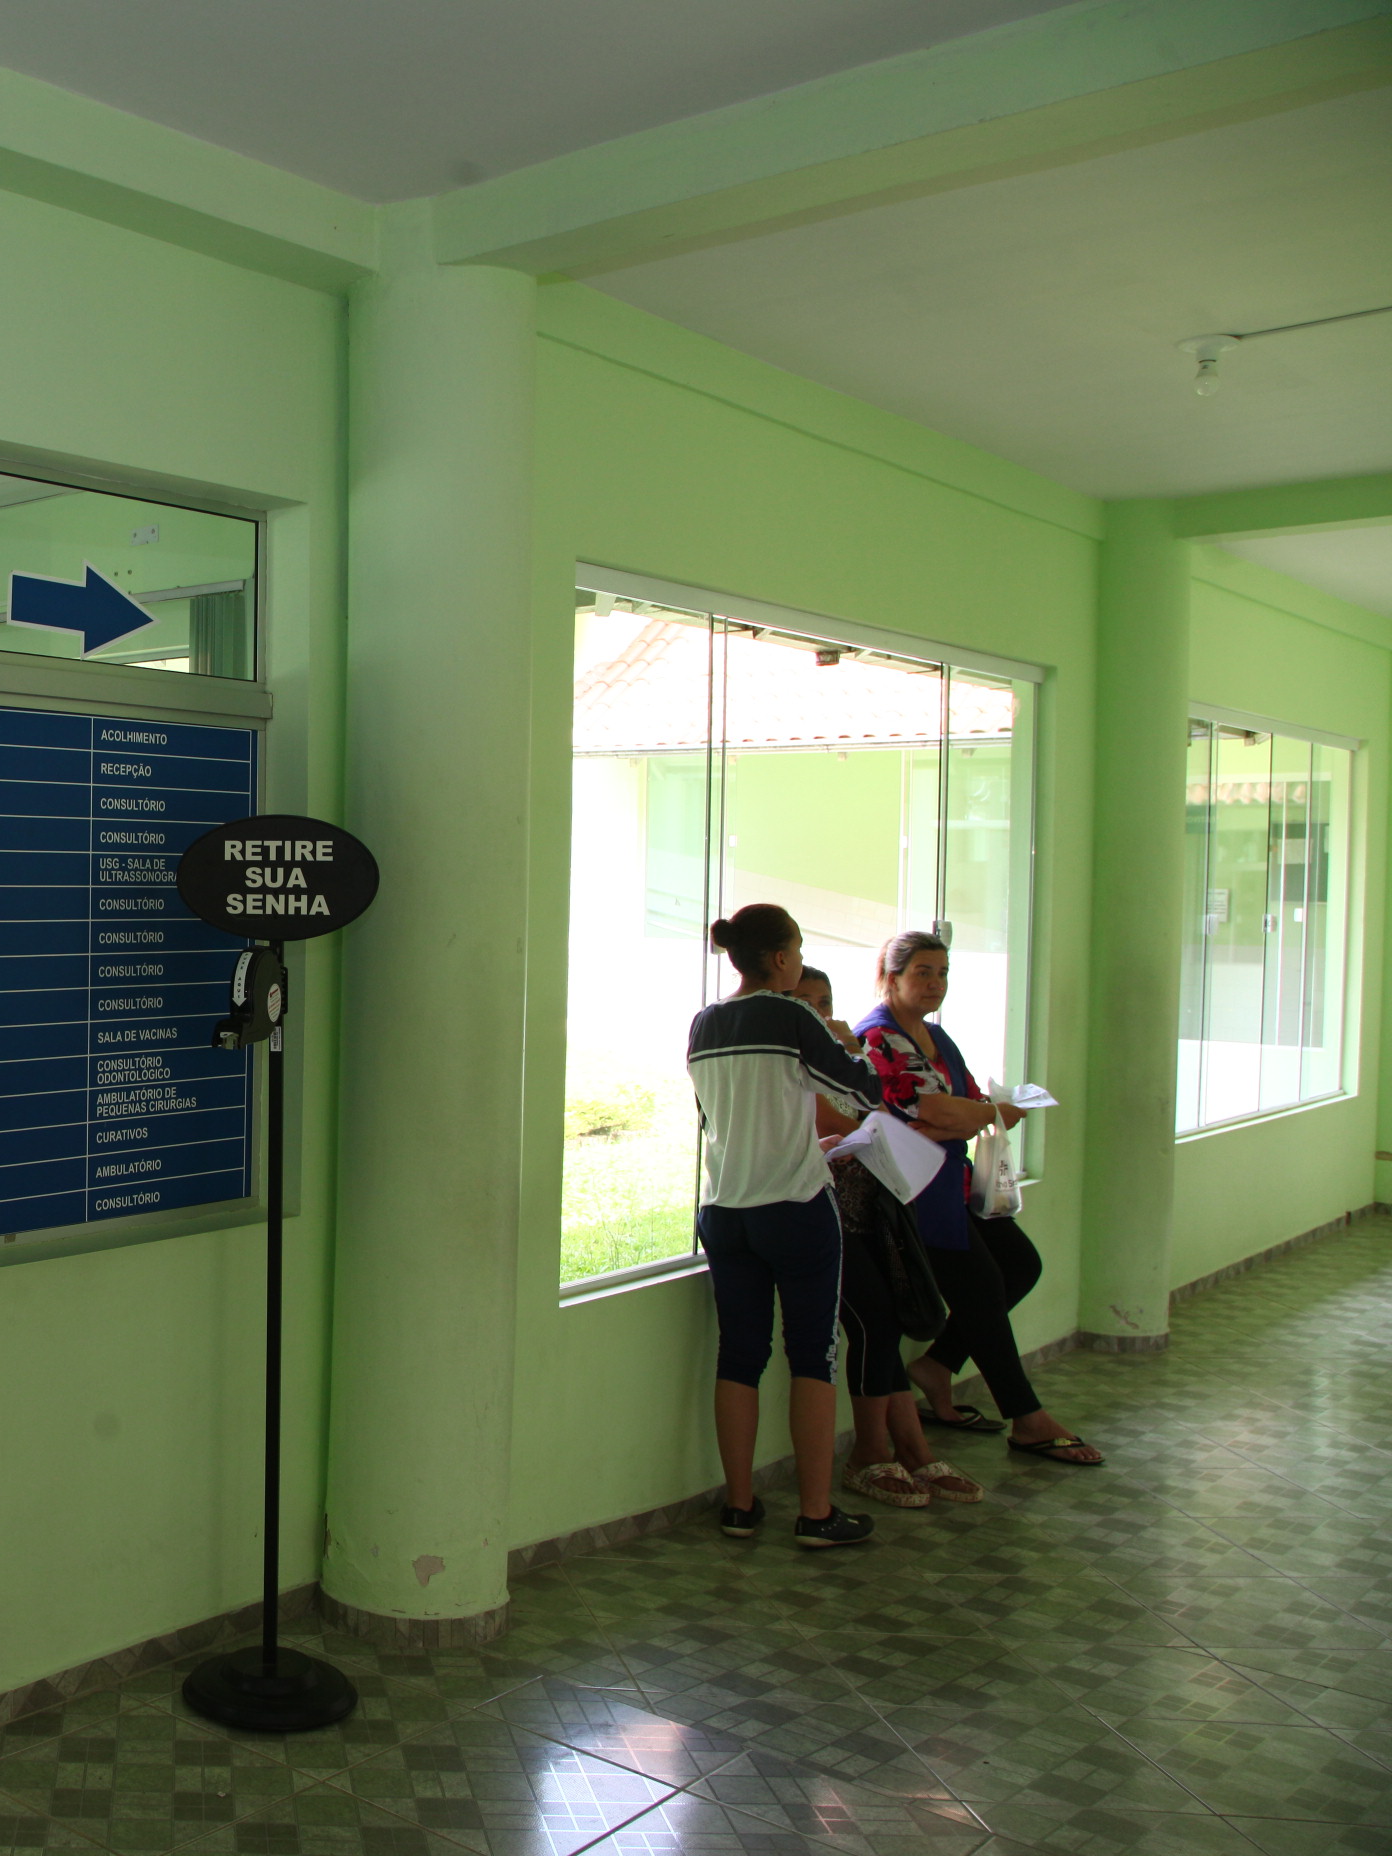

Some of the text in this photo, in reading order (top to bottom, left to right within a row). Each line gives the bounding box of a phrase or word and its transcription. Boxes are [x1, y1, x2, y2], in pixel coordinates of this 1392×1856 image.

[101, 729, 167, 745] ACOLHIMENTO
[101, 763, 152, 779] RECEPÇÃO
[100, 797, 166, 812] CONSULTÓRIO
[100, 830, 165, 845] CONSULTÓRIO
[224, 840, 334, 862] RETIRE
[99, 858, 119, 870] USG
[127, 858, 153, 870] SALA
[153, 859, 166, 870] DE
[244, 866, 308, 888] SUA
[99, 896, 165, 911] CONSULTÓRIO
[225, 893, 331, 916] SENHA
[98, 929, 164, 944] CONSULTÓRIO
[98, 963, 164, 978] CONSULTÓRIO
[98, 995, 163, 1012] CONSULTÓRIO
[97, 1027, 178, 1044] SALA DE VACINAS
[97, 1054, 163, 1072] CONSULTÓRIO
[97, 1066, 171, 1085] ODONTOLÓGICO
[96, 1086, 177, 1105] AMBULATÓRIO DE
[96, 1096, 197, 1118] PEQUENAS CIRURGIAS
[96, 1126, 148, 1144] CURATIVOS
[96, 1158, 162, 1179] AMBULATÓRIO
[95, 1190, 161, 1211] CONSULTÓRIO
